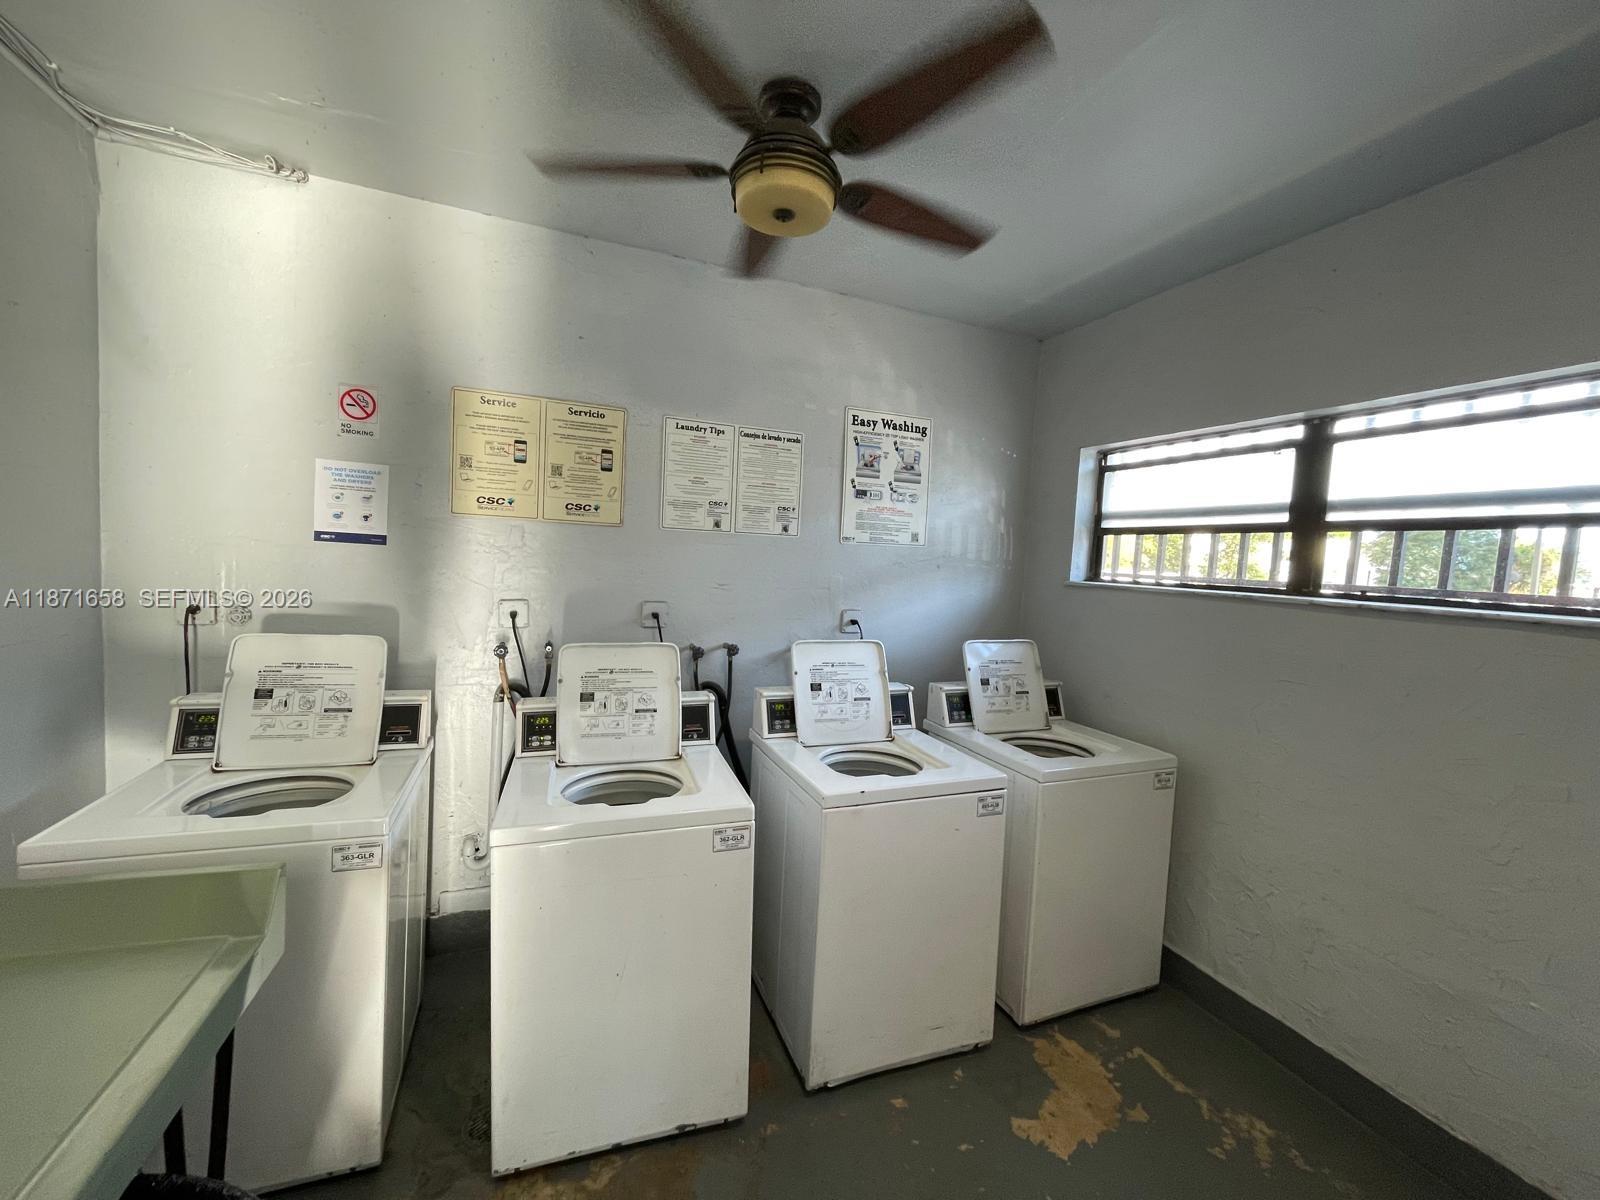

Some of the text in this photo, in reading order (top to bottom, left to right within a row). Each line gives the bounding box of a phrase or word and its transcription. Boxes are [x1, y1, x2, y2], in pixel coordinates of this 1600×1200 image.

[480, 396, 517, 408] Service
[568, 406, 606, 419] Servicio
[675, 422, 725, 436] Laundry Tips
[851, 414, 928, 438] Easy Washing
[341, 428, 374, 436] SMOKING
[740, 430, 760, 440] Consejos
[768, 434, 782, 442] lavado
[476, 496, 506, 505] CSC
[565, 502, 592, 512] CSC
[720, 834, 744, 842] 362-GLR
[340, 852, 375, 861] 363-GLR
